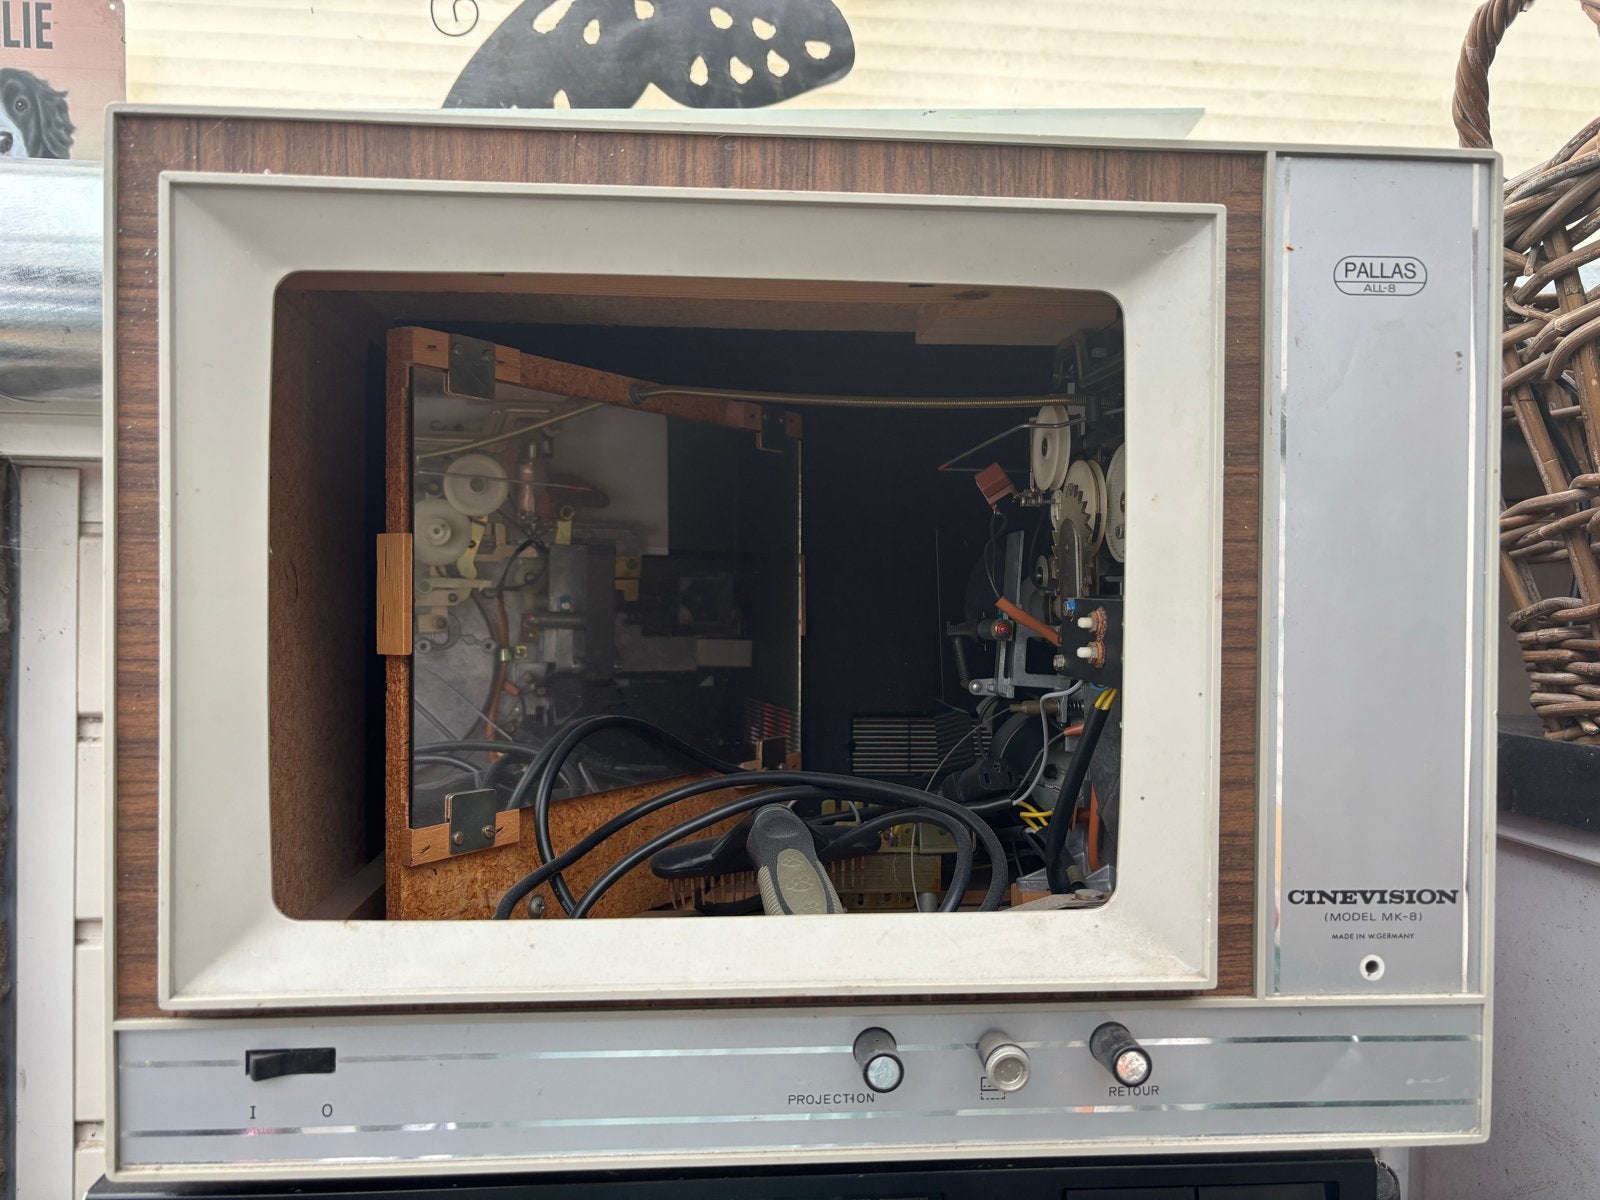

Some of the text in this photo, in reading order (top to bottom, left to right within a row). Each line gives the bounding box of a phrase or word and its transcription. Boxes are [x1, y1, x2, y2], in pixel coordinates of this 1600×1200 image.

[0, 1, 53, 49] LIE
[1344, 262, 1416, 279] PALLAS
[1363, 284, 1396, 293] ALL-8
[1287, 889, 1459, 905] CINEVISION
[1324, 912, 1423, 922] (MODEL MK-8)
[1108, 1085, 1159, 1096] RETOUR
[788, 1093, 875, 1104] PROJECTION
